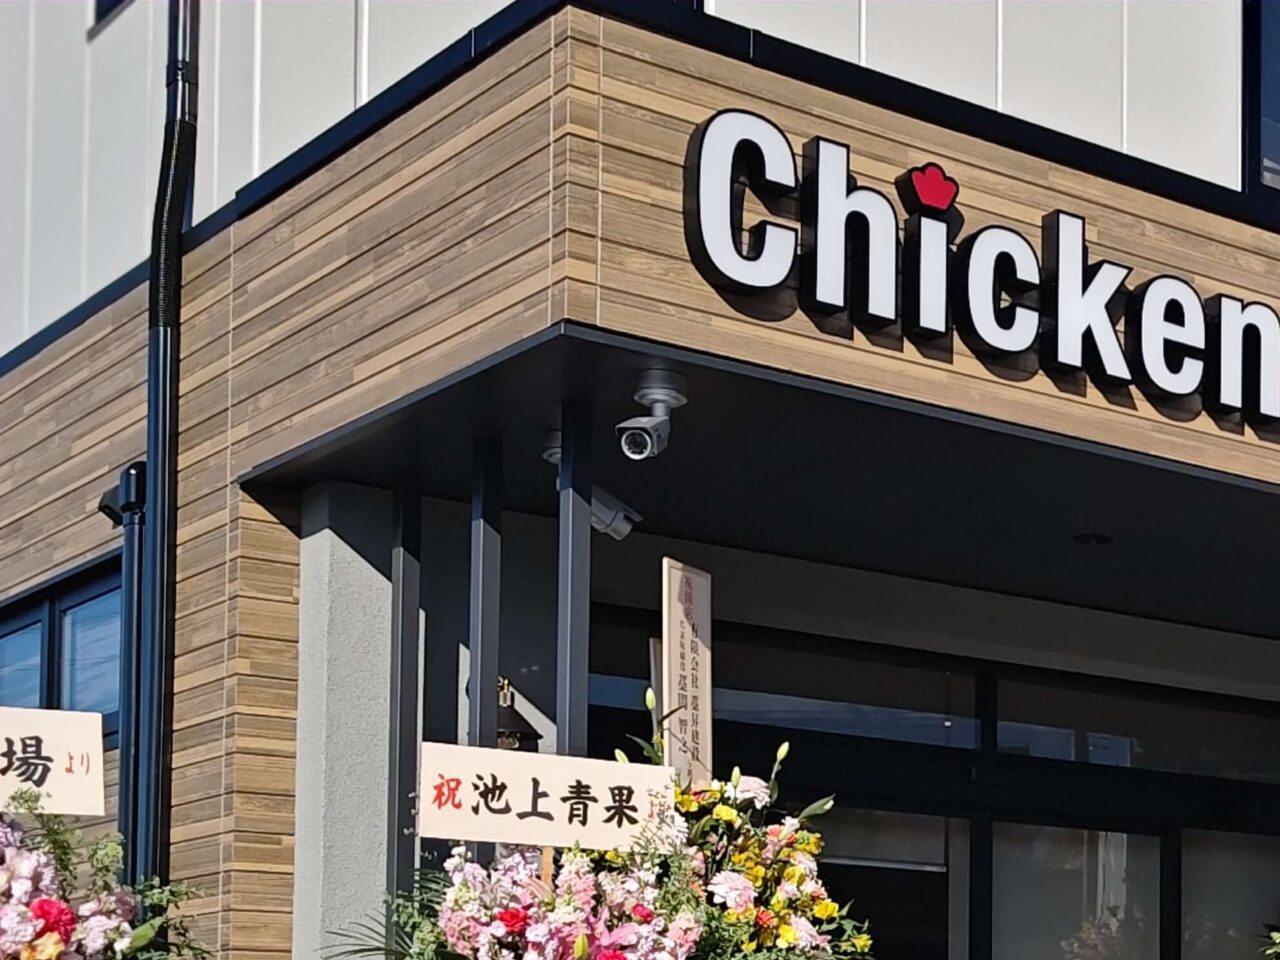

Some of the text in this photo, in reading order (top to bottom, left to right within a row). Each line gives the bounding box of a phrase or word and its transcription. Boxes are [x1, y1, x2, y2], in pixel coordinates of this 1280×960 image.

[64, 751, 91, 776] より
[431, 772, 463, 811] 祝
[470, 772, 641, 829] 池上青果
